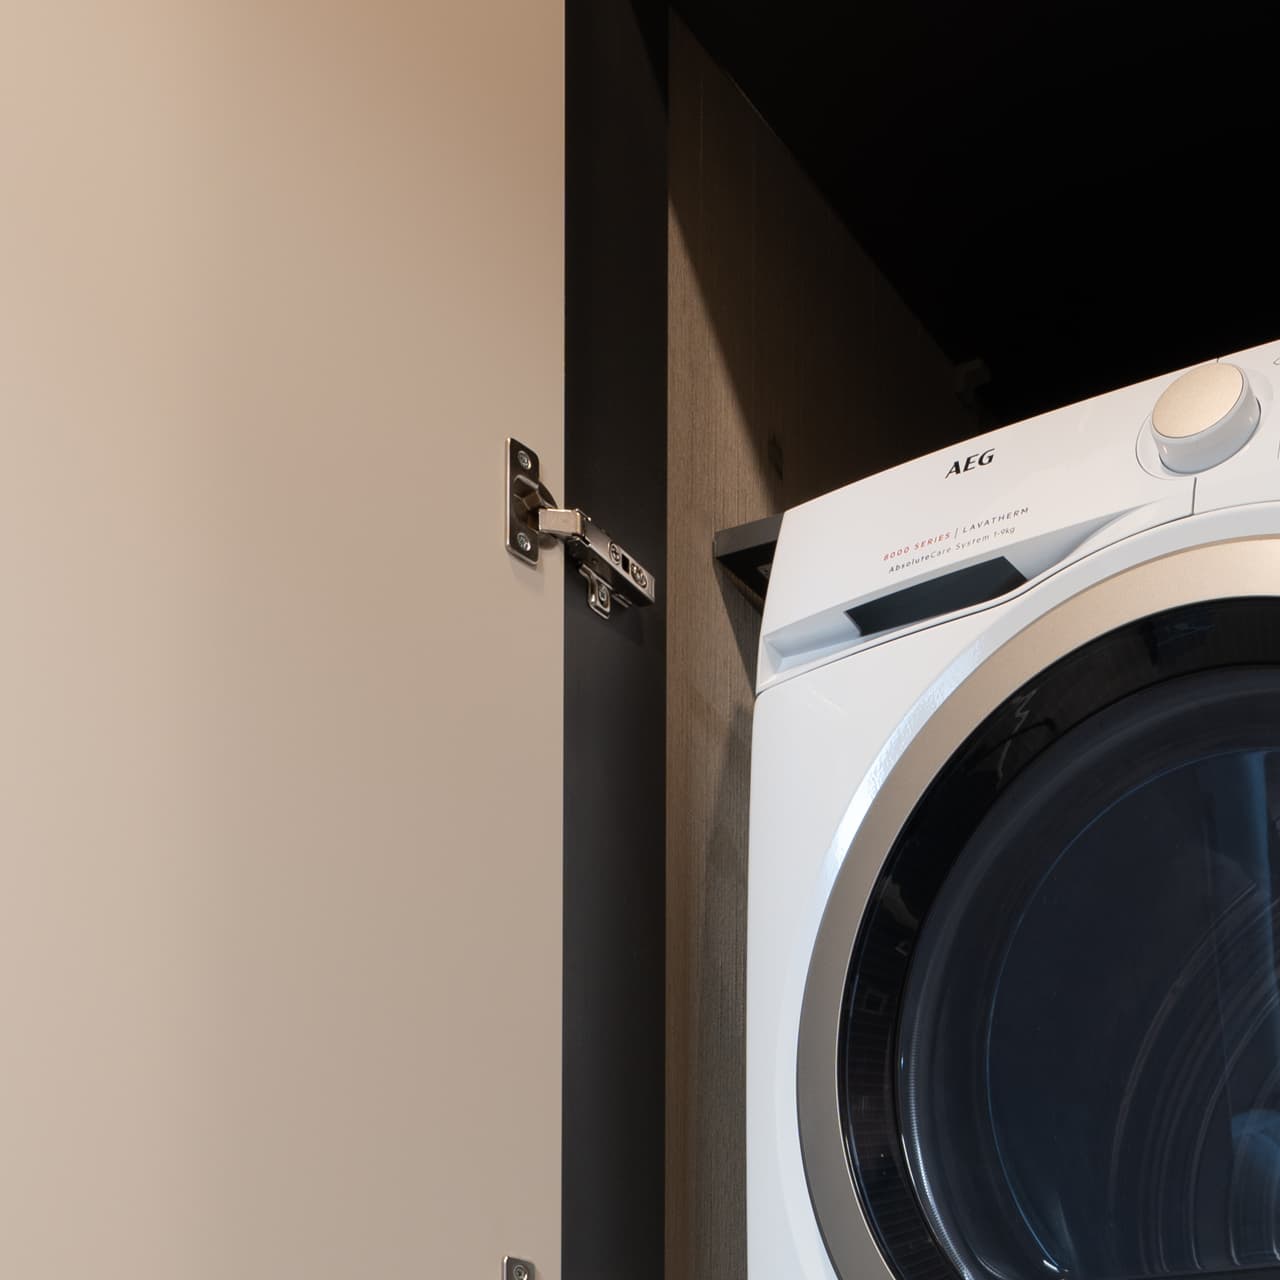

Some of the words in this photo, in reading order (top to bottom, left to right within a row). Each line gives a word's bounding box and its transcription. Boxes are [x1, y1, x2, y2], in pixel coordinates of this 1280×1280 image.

[944, 448, 996, 479] AEG
[883, 546, 911, 561] 8000
[914, 531, 951, 551] SERIES
[962, 507, 1030, 534] LAVATHERM
[888, 547, 952, 574] AbsoluteCare
[955, 534, 991, 551] System
